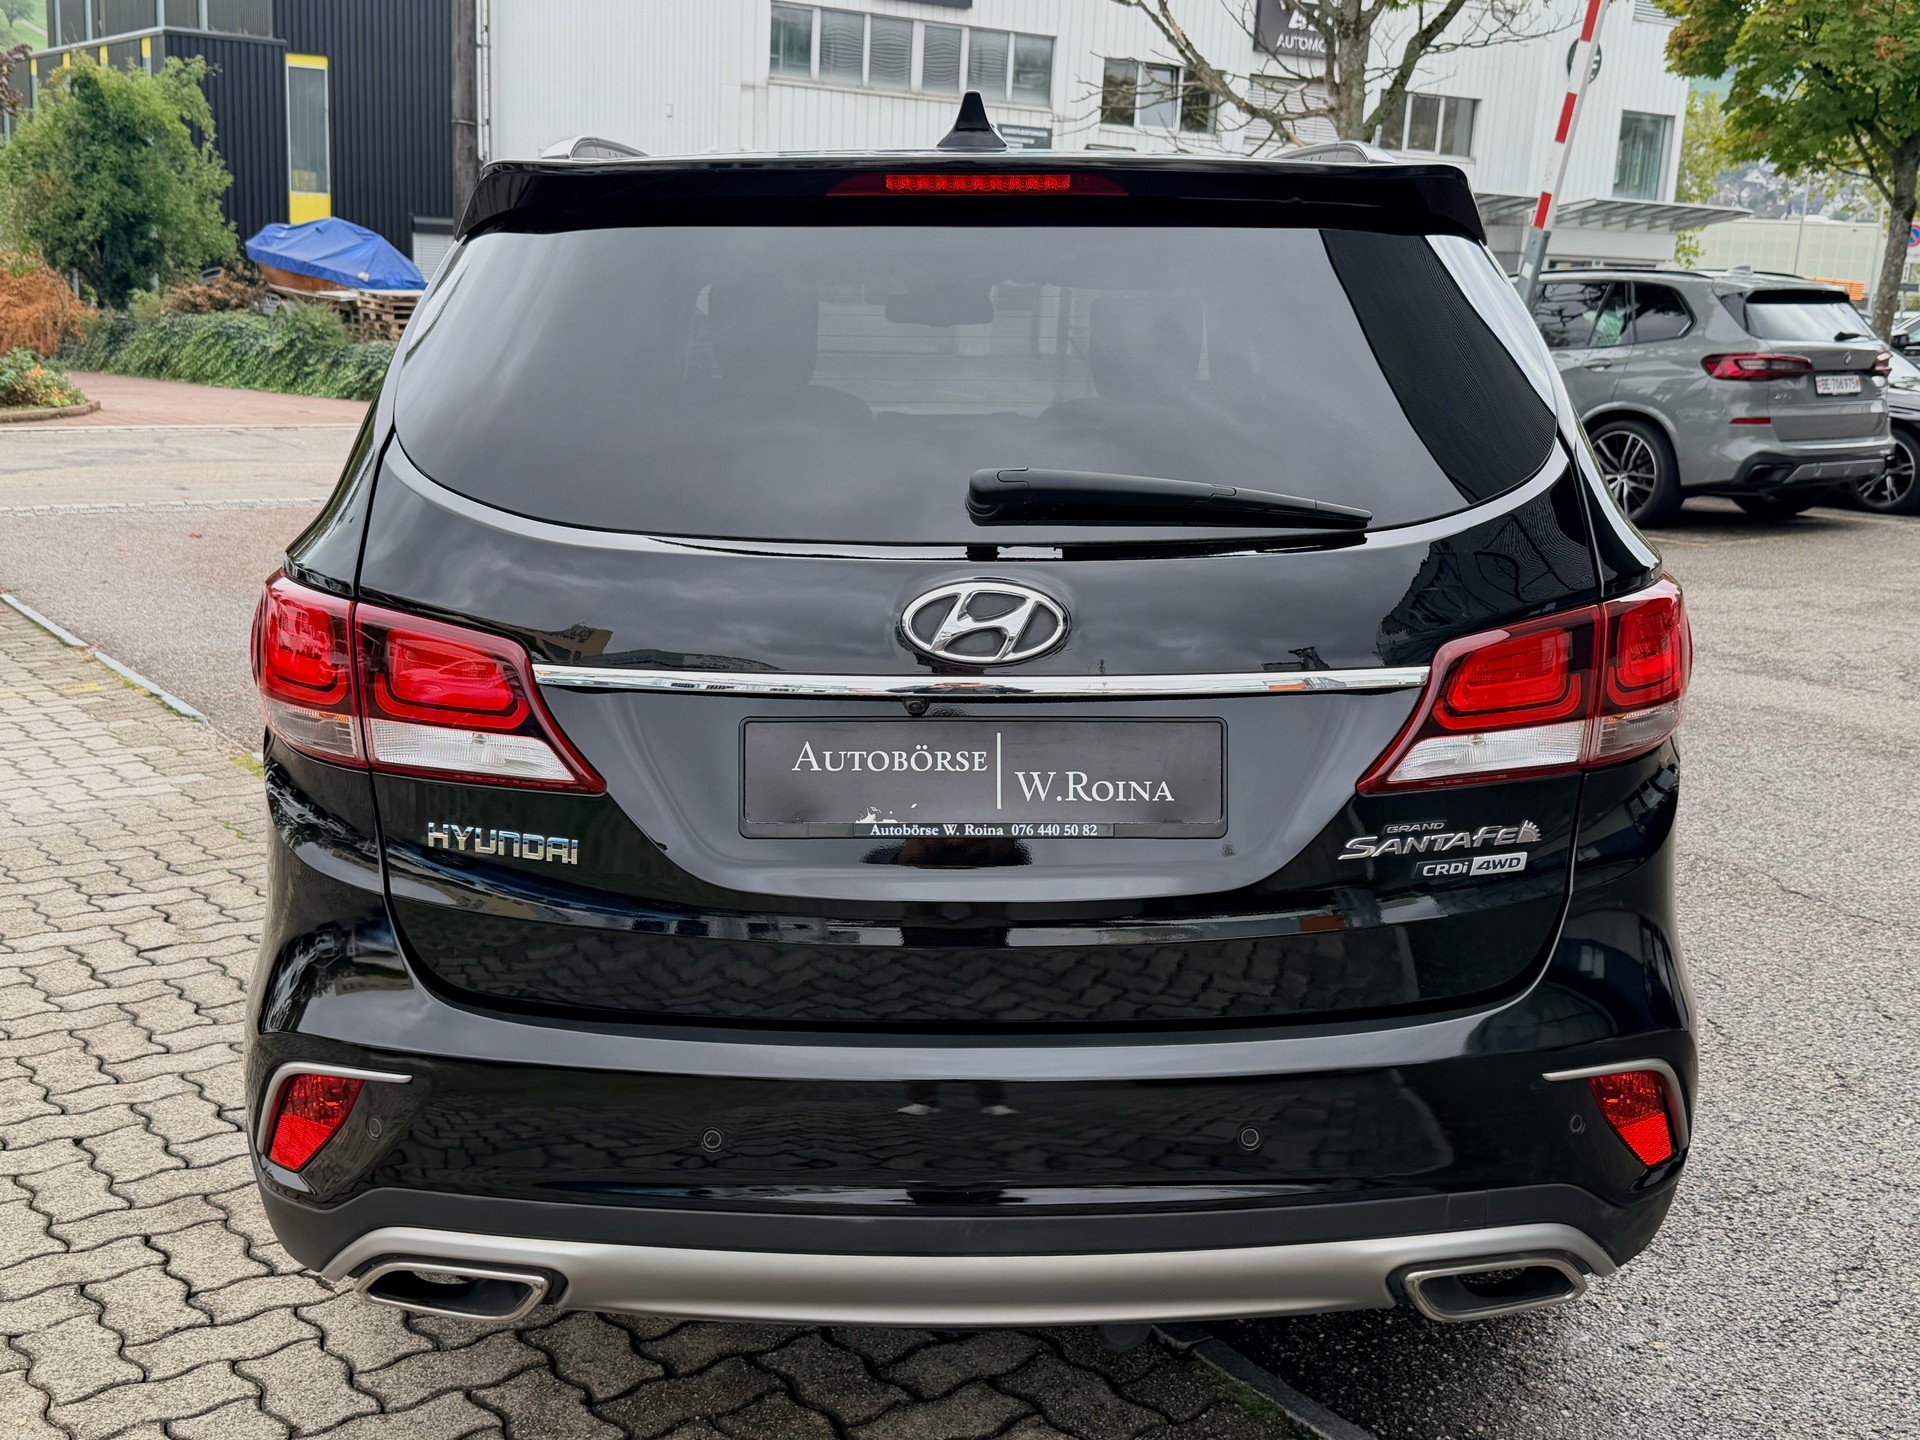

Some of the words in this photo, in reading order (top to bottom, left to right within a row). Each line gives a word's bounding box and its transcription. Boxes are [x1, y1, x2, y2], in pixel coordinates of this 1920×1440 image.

[791, 740, 988, 772] AUTOBÖRSE
[869, 823, 939, 836] Autobörse
[943, 824, 960, 836] W.
[964, 824, 1004, 836] Roina
[1011, 824, 1033, 836] 076
[1037, 824, 1060, 836] 440
[1063, 824, 1079, 836] 50
[1082, 824, 1098, 836] 82
[1386, 822, 1445, 834] GRAND
[427, 822, 579, 865] HYUNDAI
[1422, 861, 1468, 877] CRDi
[1476, 857, 1521, 871] 4WD
